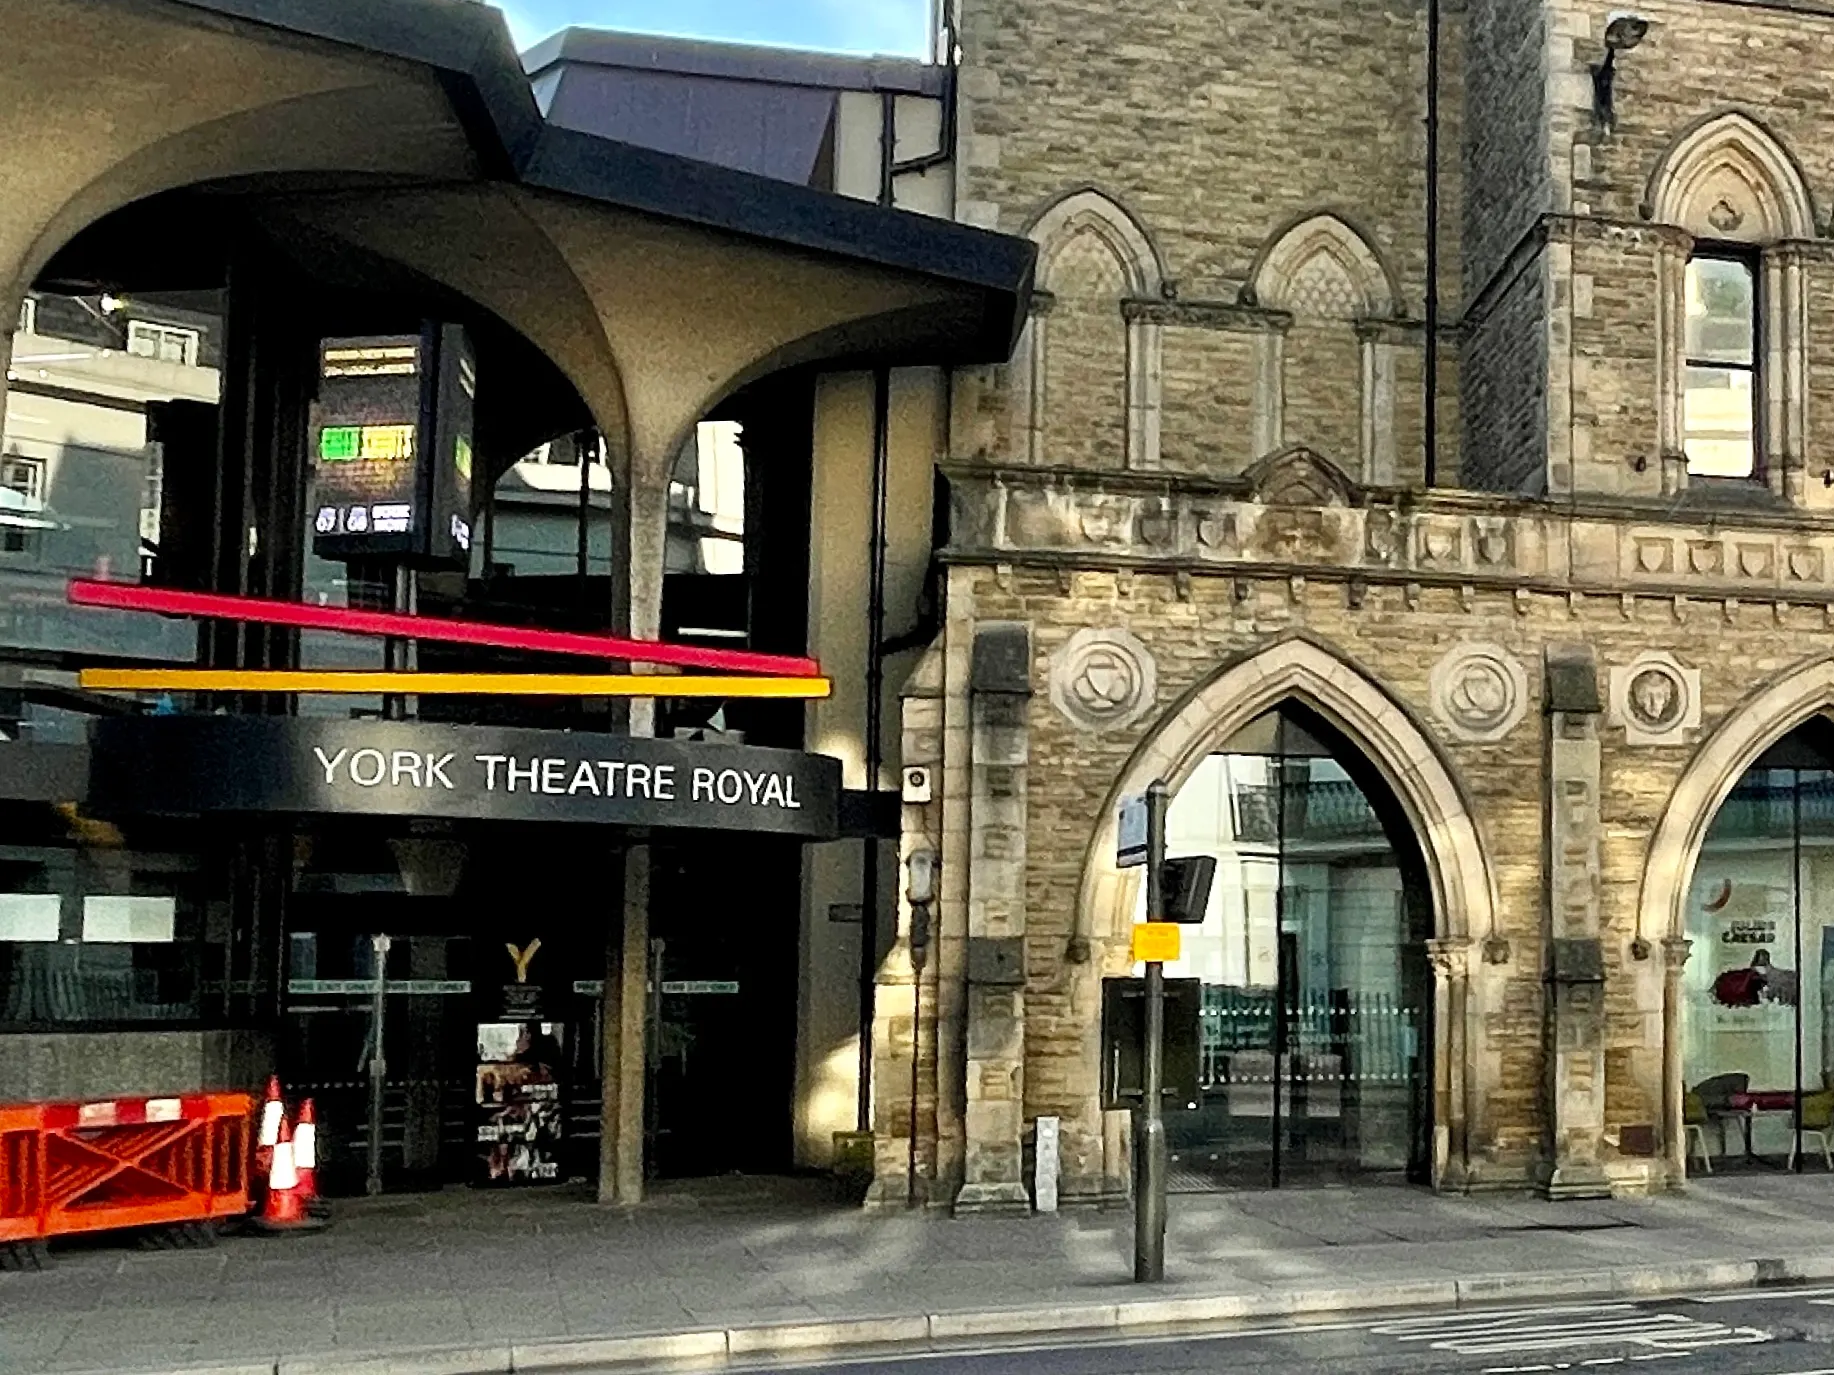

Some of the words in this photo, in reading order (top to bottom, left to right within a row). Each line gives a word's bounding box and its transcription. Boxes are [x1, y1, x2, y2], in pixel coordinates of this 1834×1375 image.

[313, 747, 455, 789] YORK
[475, 755, 676, 800] THEATRE
[691, 768, 802, 808] ROYAL
